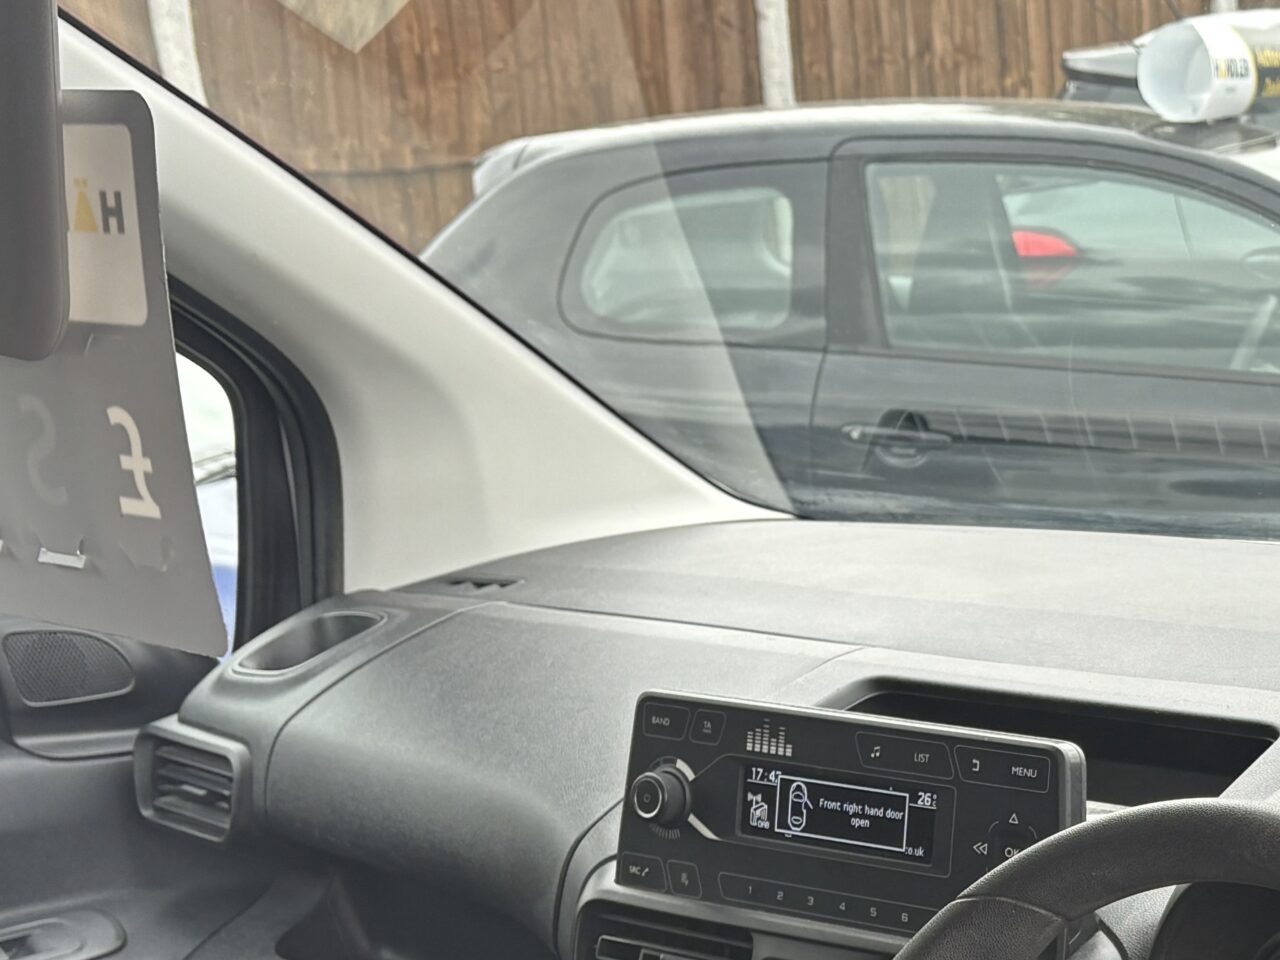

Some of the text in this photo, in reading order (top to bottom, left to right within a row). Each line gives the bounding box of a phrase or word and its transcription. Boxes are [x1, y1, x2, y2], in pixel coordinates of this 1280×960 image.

[913, 752, 930, 763] LIST
[1011, 766, 1038, 778] MENU
[819, 798, 904, 820] Front right hand door
[850, 817, 870, 829] open
[776, 890, 784, 900] 2
[807, 896, 814, 906] 3
[839, 902, 846, 911] 4
[869, 907, 877, 917] 5
[901, 912, 909, 922] 6
